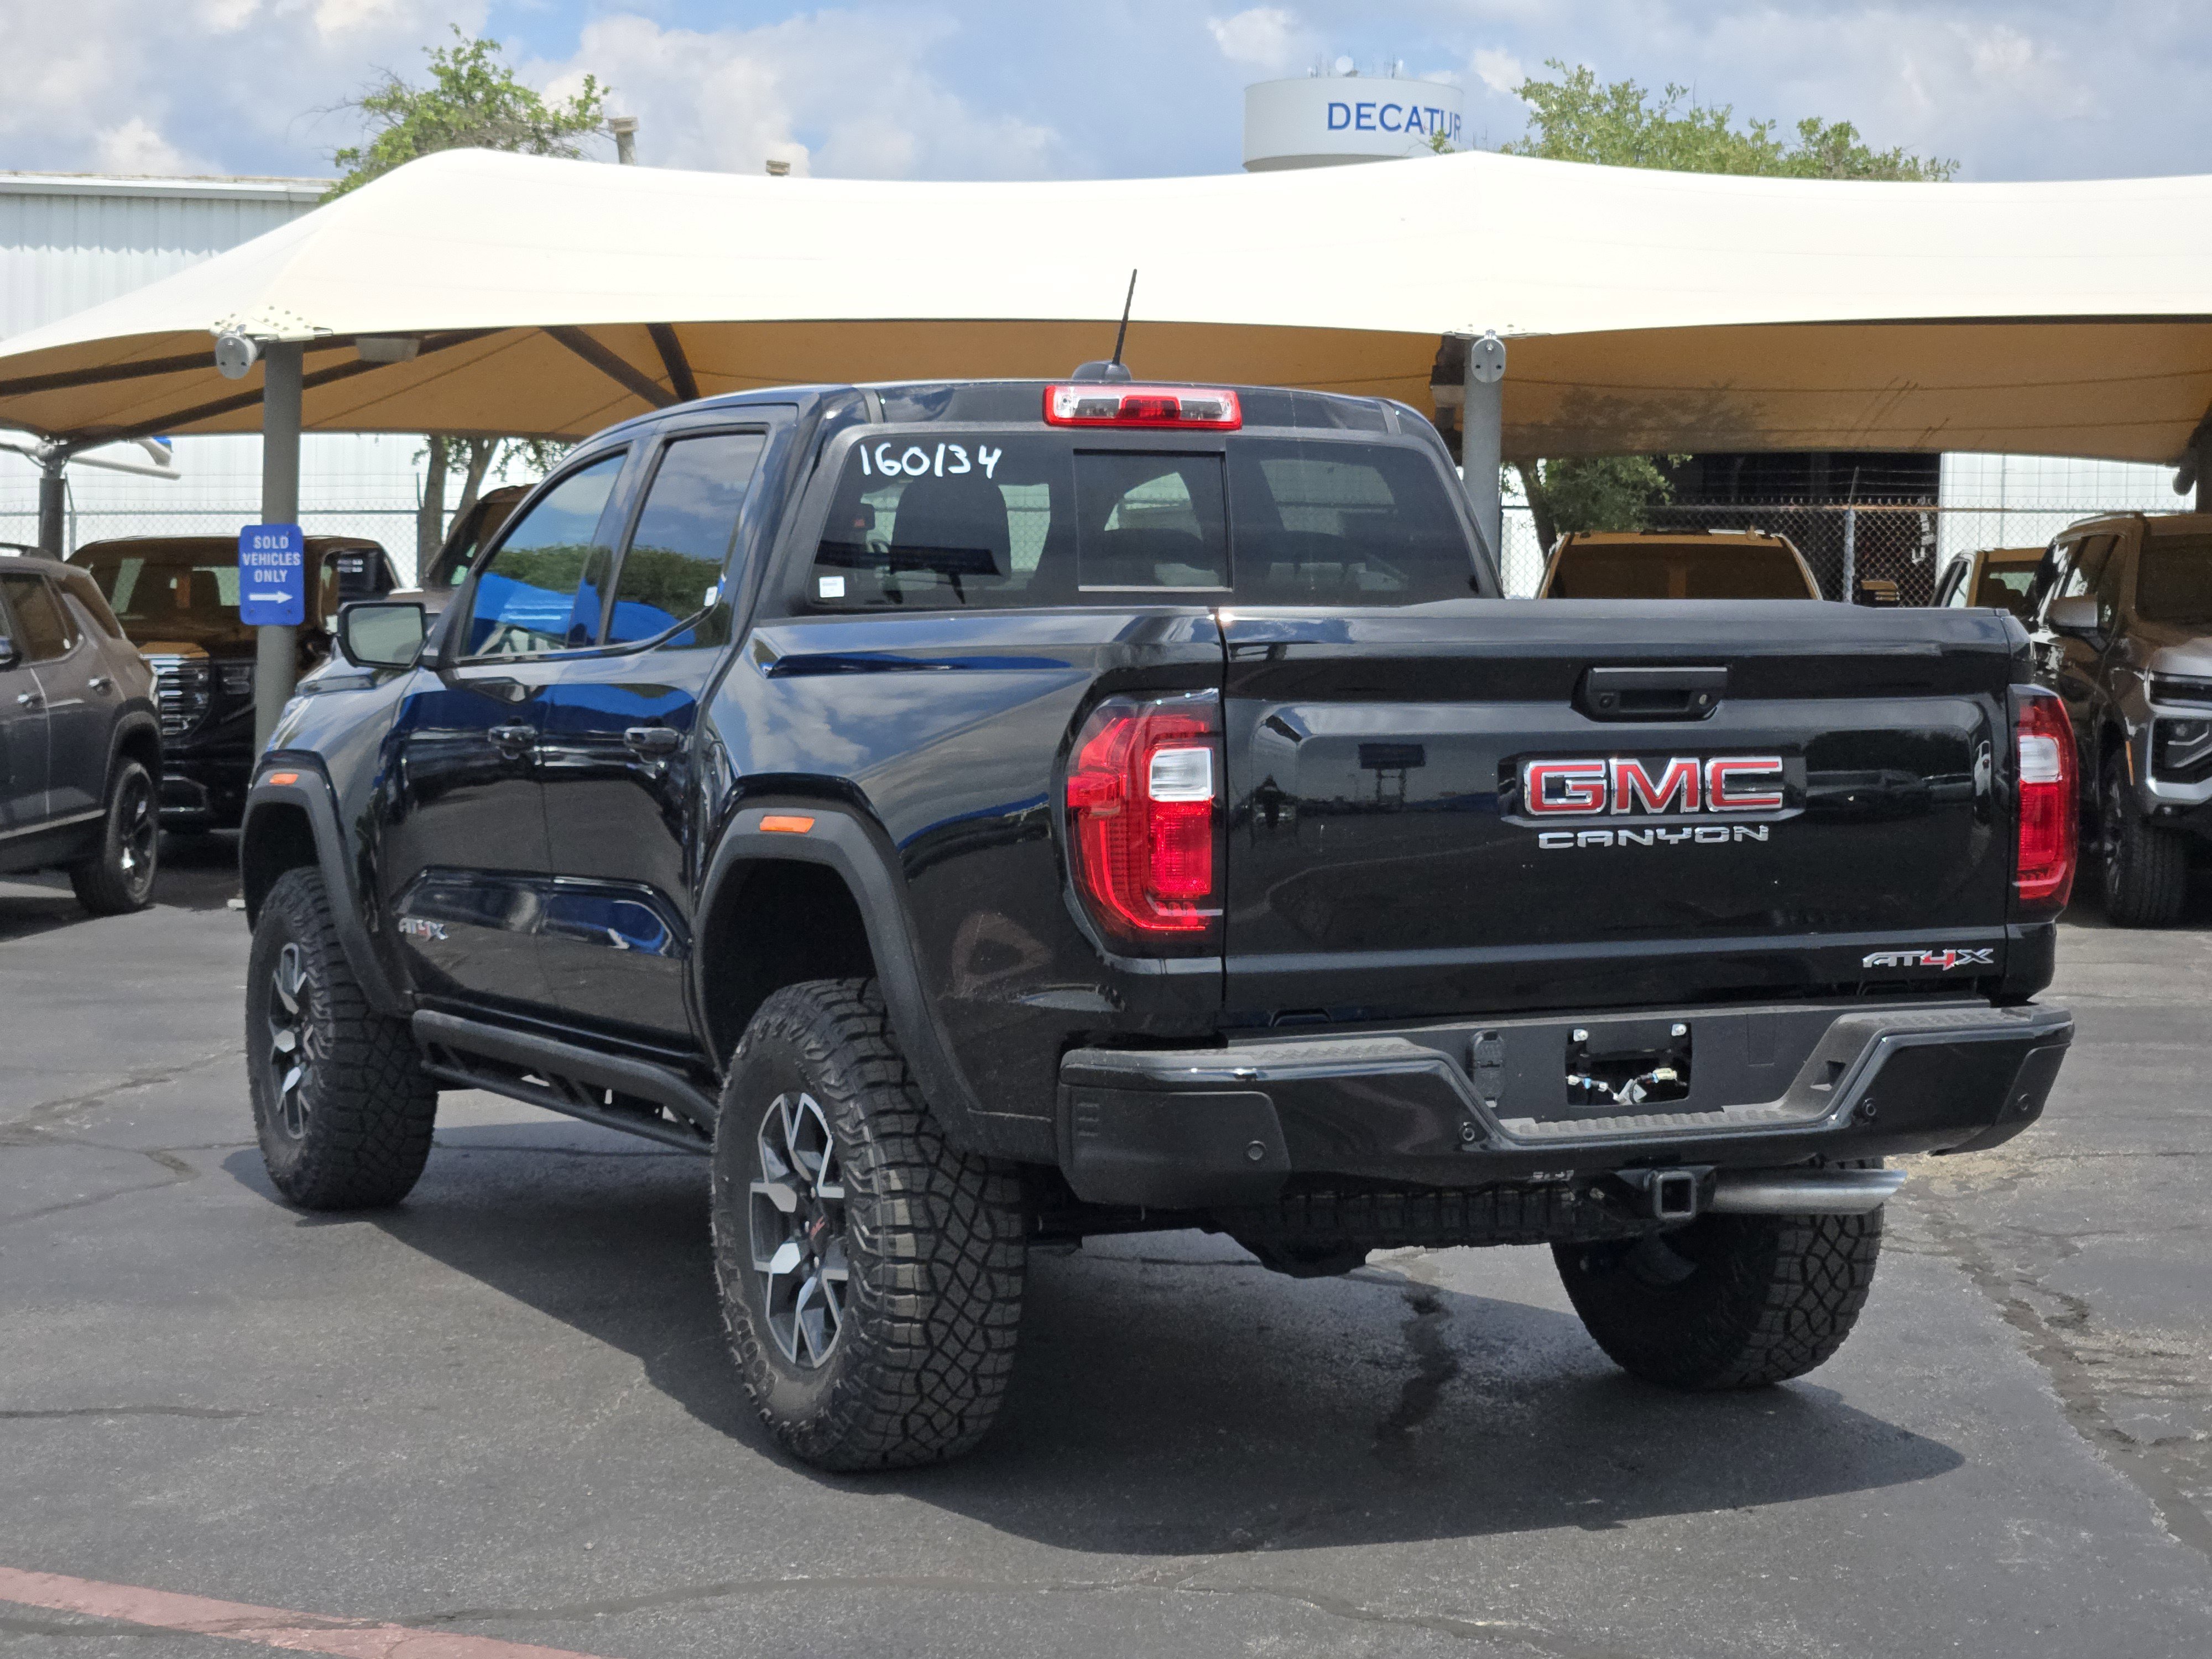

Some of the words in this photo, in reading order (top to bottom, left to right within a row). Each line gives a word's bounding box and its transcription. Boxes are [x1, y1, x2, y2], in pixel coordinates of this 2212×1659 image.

[1328, 102, 1462, 142] DECATUR
[860, 442, 1002, 479] 160134
[253, 535, 289, 549] SOLD
[242, 552, 301, 566] VEHICLES
[254, 570, 288, 583] ONLY
[1524, 756, 1783, 816] GMC
[1538, 825, 1768, 849] CANYON
[1863, 948, 1994, 971] AT4X
